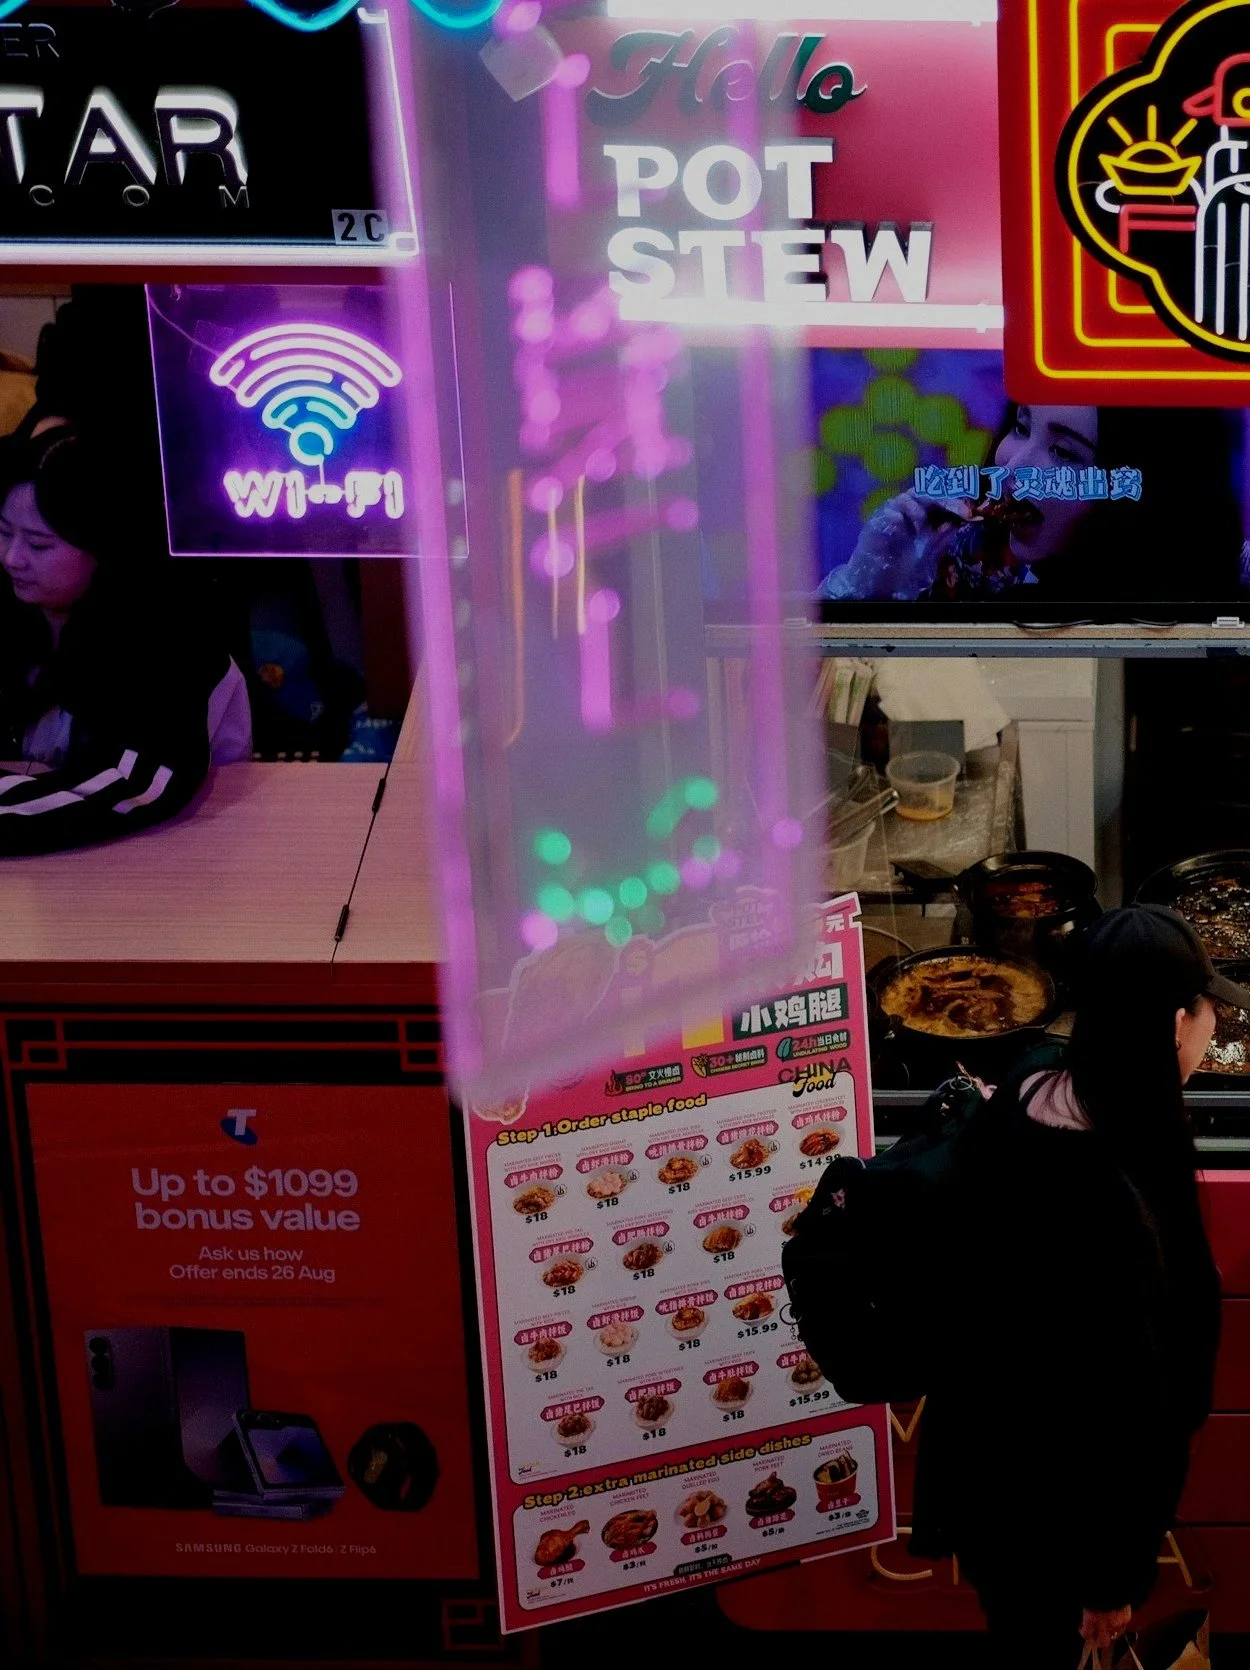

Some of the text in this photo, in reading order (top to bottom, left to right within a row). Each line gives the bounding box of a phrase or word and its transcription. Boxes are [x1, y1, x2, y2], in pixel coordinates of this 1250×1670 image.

[587, 28, 868, 125] Hello
[603, 138, 835, 220] POT
[607, 221, 934, 302] STEW
[913, 464, 1143, 501] 吃到了灵魂出窍
[740, 987, 842, 1034] 小鸡腿
[829, 1042, 848, 1051] WOOD
[778, 1057, 852, 1084] CHINA
[792, 1071, 836, 1098] Food
[497, 1093, 707, 1146] Step 1:Order staple food
[729, 1166, 772, 1182] $15.99
[131, 1165, 359, 1202] Up to $1099
[668, 1182, 691, 1195] $18
[597, 1197, 619, 1209] $18
[135, 1202, 361, 1232] bonus value
[525, 1211, 549, 1223] $18
[200, 1246, 303, 1262] Ask us how
[713, 1251, 735, 1263] $18
[169, 1263, 336, 1284] Offer ends 26 Aug
[632, 1268, 655, 1281] $18
[552, 1285, 576, 1297] $18
[737, 1322, 778, 1339] $15.99
[678, 1338, 701, 1351] $18
[606, 1354, 631, 1367] $18
[535, 1370, 558, 1383] $18
[789, 1390, 830, 1407] $15.99
[722, 1409, 745, 1422] $18
[642, 1427, 666, 1441] $18
[564, 1445, 587, 1458] $18
[819, 1440, 852, 1451] MARINATED
[753, 1456, 785, 1467] MARINATED
[754, 1461, 784, 1473] PORK FEET
[523, 1433, 812, 1510] Step 2:extra marinated side dishes
[684, 1471, 717, 1483] MARINATED
[610, 1496, 636, 1507] CHICKEN
[540, 1505, 575, 1516] MARINATED
[175, 1542, 242, 1553] SAMSUNG
[245, 1543, 290, 1556] Galaxy
[291, 1544, 299, 1554] Z
[300, 1543, 334, 1555] Fold6
[349, 1544, 377, 1556] Flip6
[703, 1568, 720, 1578] THE
[720, 1562, 743, 1575] SAME
[744, 1557, 761, 1569] DAY
